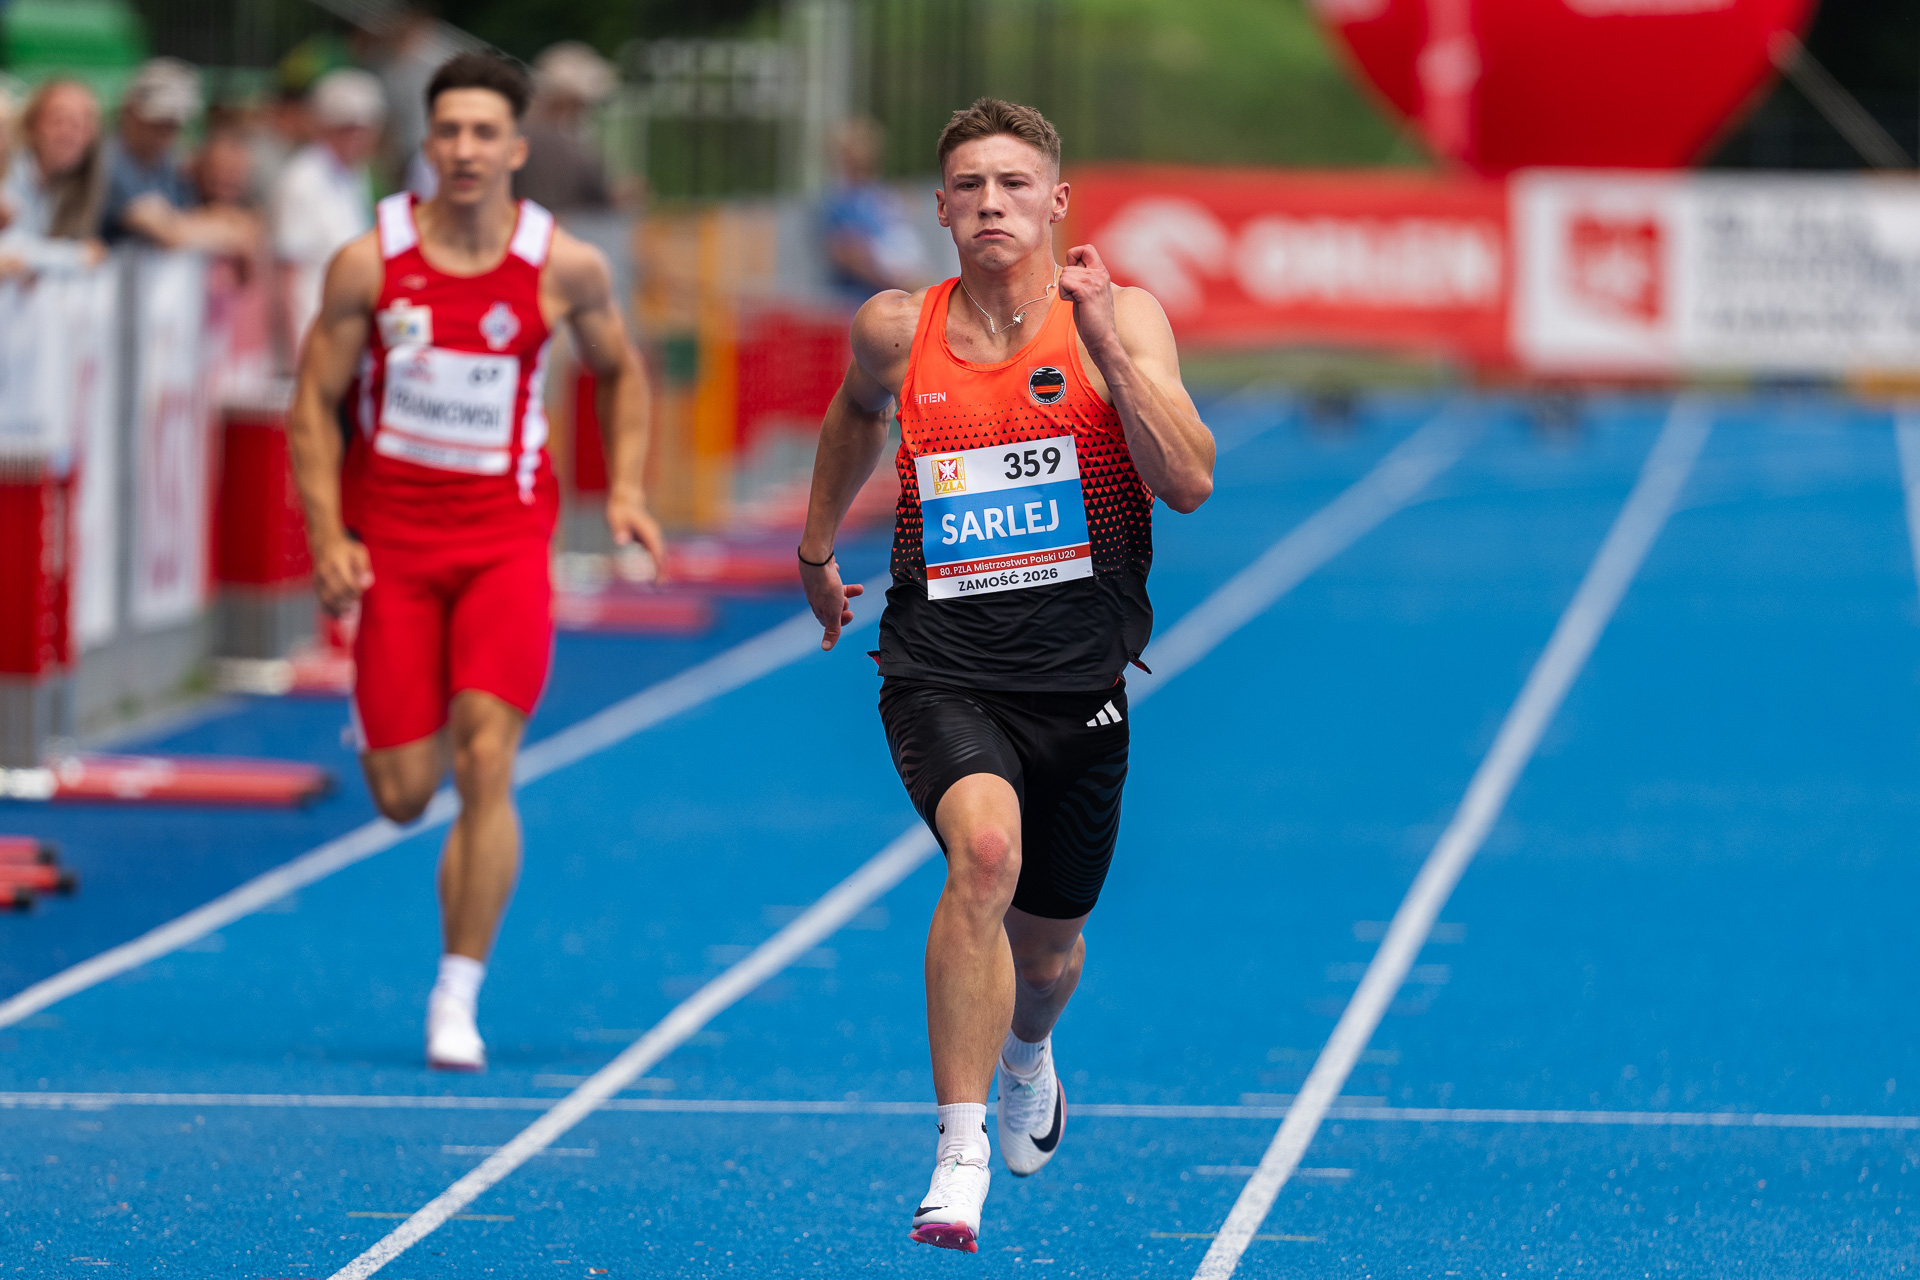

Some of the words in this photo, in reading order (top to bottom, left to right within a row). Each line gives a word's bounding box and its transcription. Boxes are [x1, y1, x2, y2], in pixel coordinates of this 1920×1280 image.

[918, 391, 946, 404] ITEN
[1003, 447, 1061, 480] 359
[935, 481, 964, 493] PZLA
[941, 499, 1060, 545] SARLEJ
[939, 567, 953, 576] 80.
[953, 566, 972, 574] PZLA
[974, 558, 1028, 571] Mistrzostwa
[1030, 552, 1056, 564] Polski
[1058, 549, 1076, 559] U20
[958, 570, 1019, 591] ZAMOŚĆ
[1023, 568, 1058, 583] 2026
